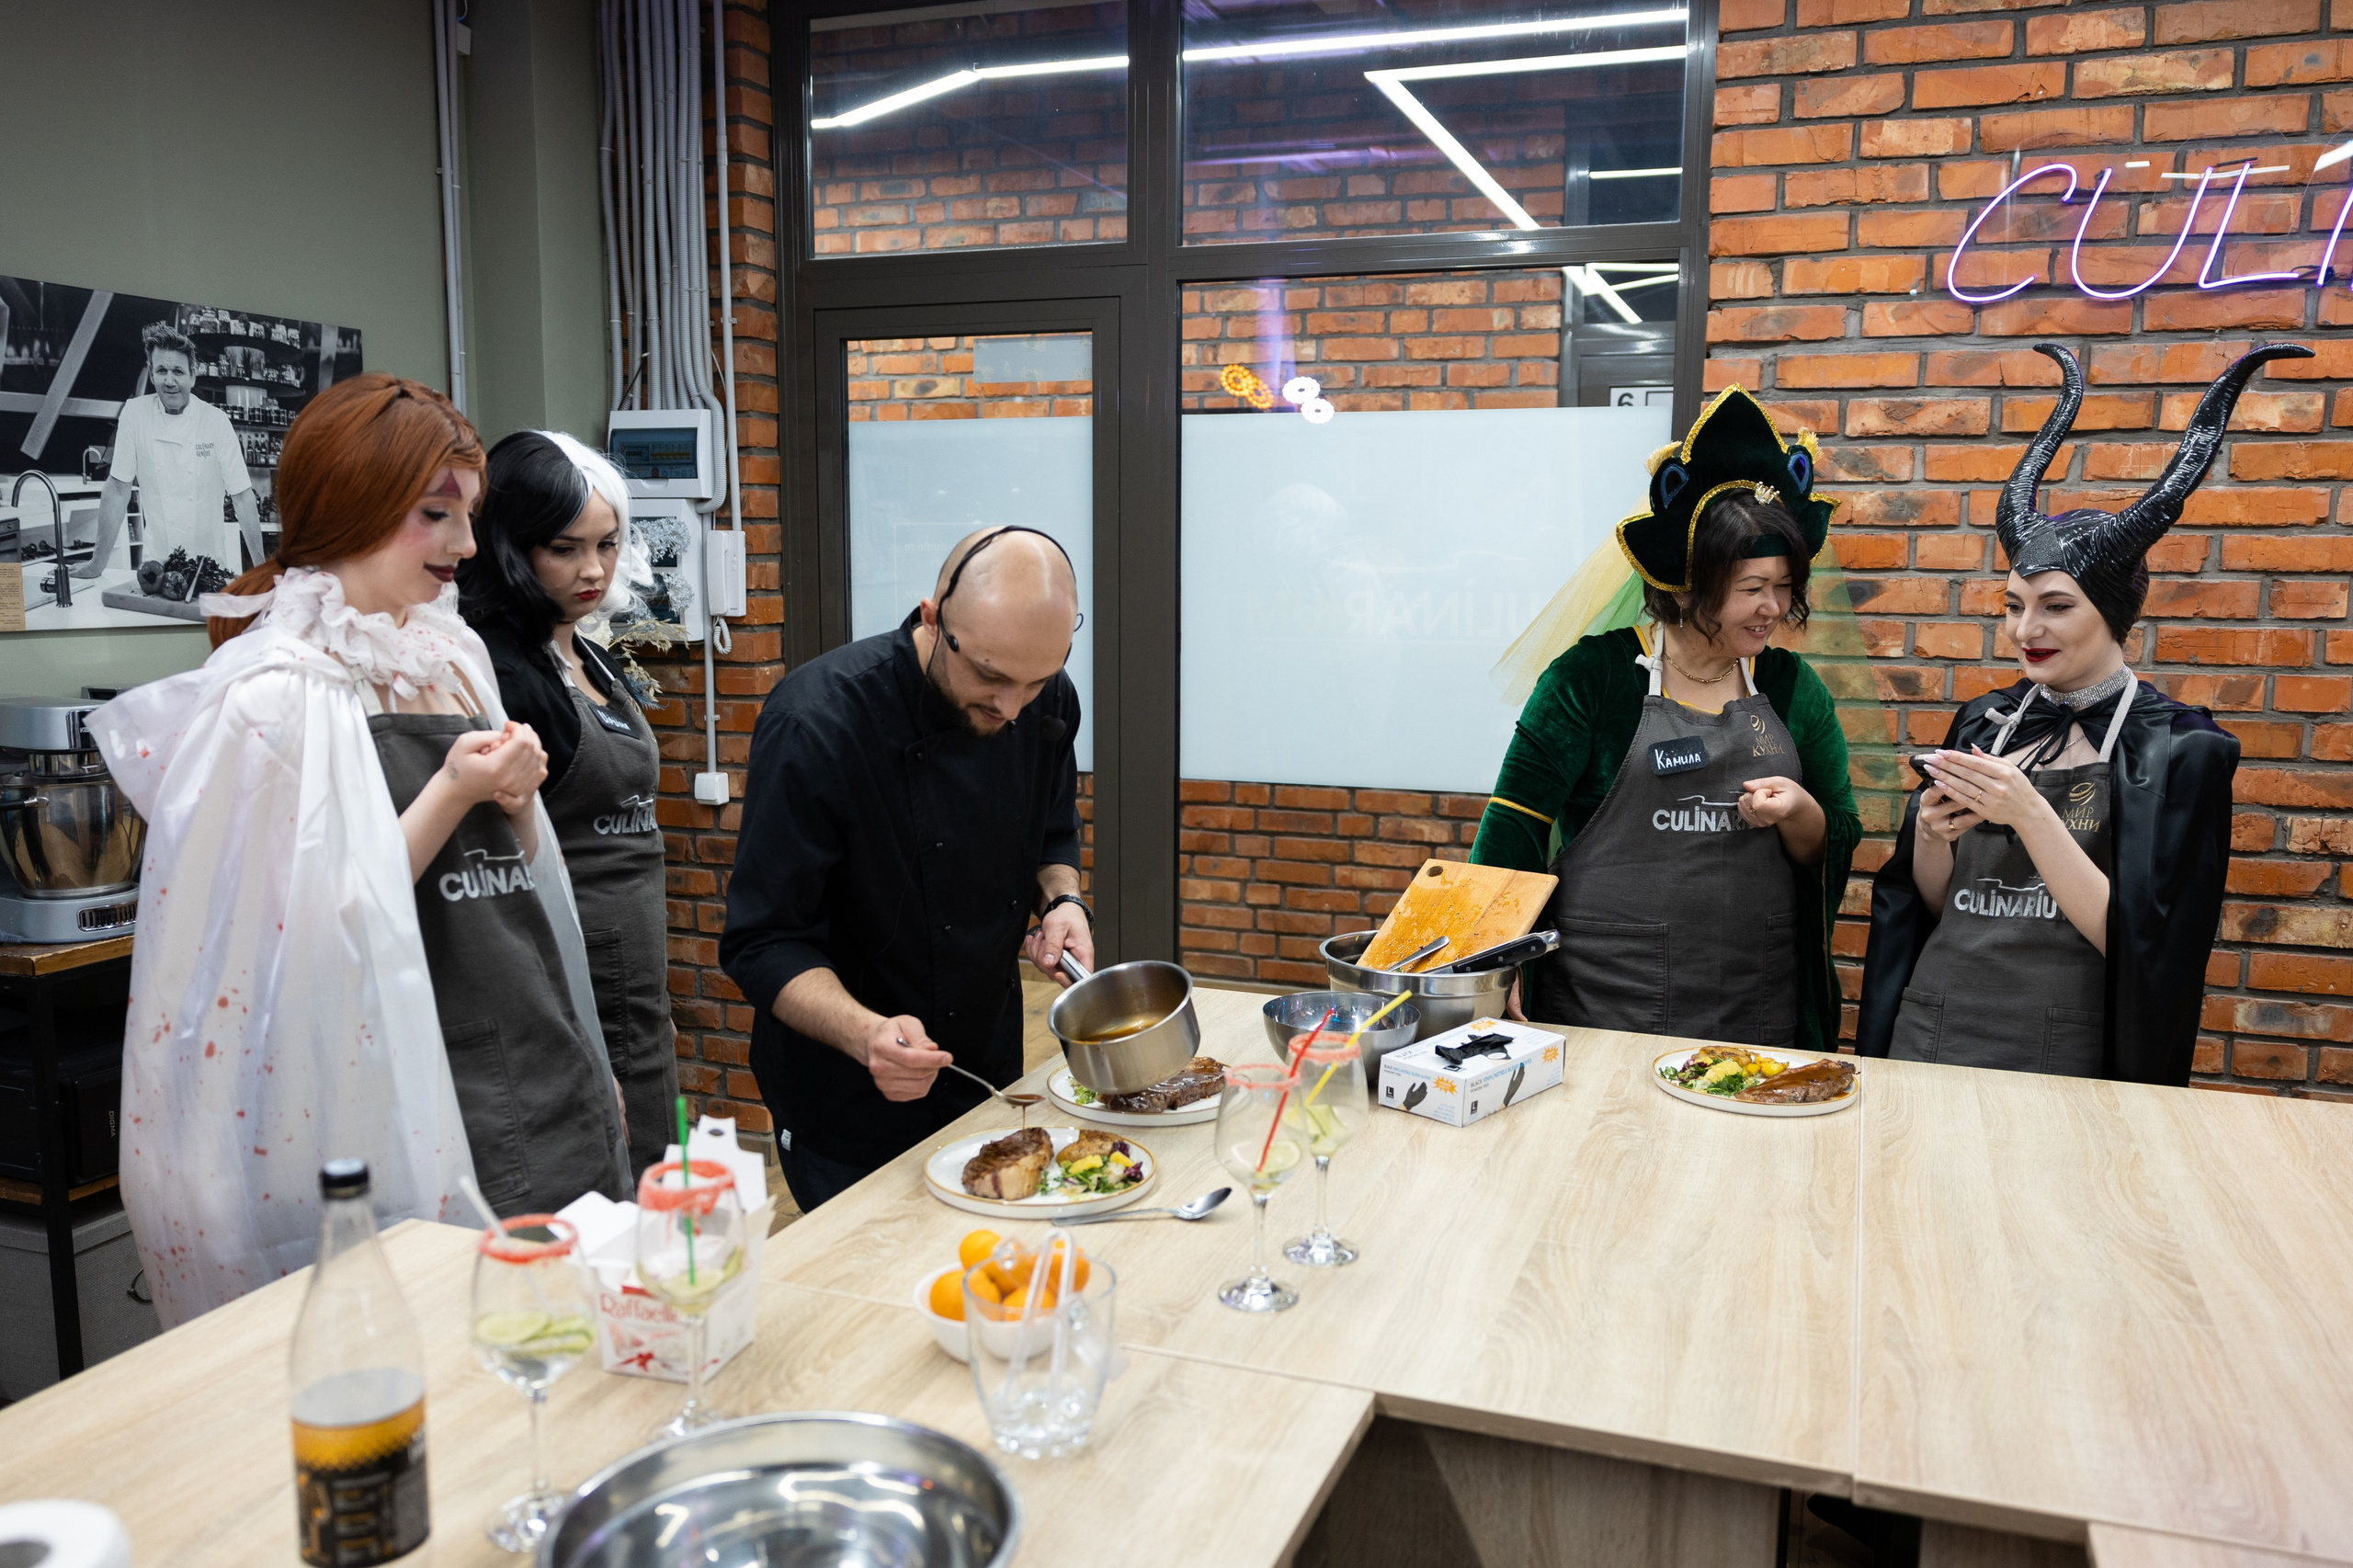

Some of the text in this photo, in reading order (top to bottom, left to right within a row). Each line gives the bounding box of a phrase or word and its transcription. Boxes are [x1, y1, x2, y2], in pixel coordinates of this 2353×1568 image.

[1752, 744, 1785, 757] КУХНИ
[2062, 806, 2095, 818] МИР
[1954, 889, 2060, 919] CULINARIU
[108, 1110, 117, 1138] DIGMA
